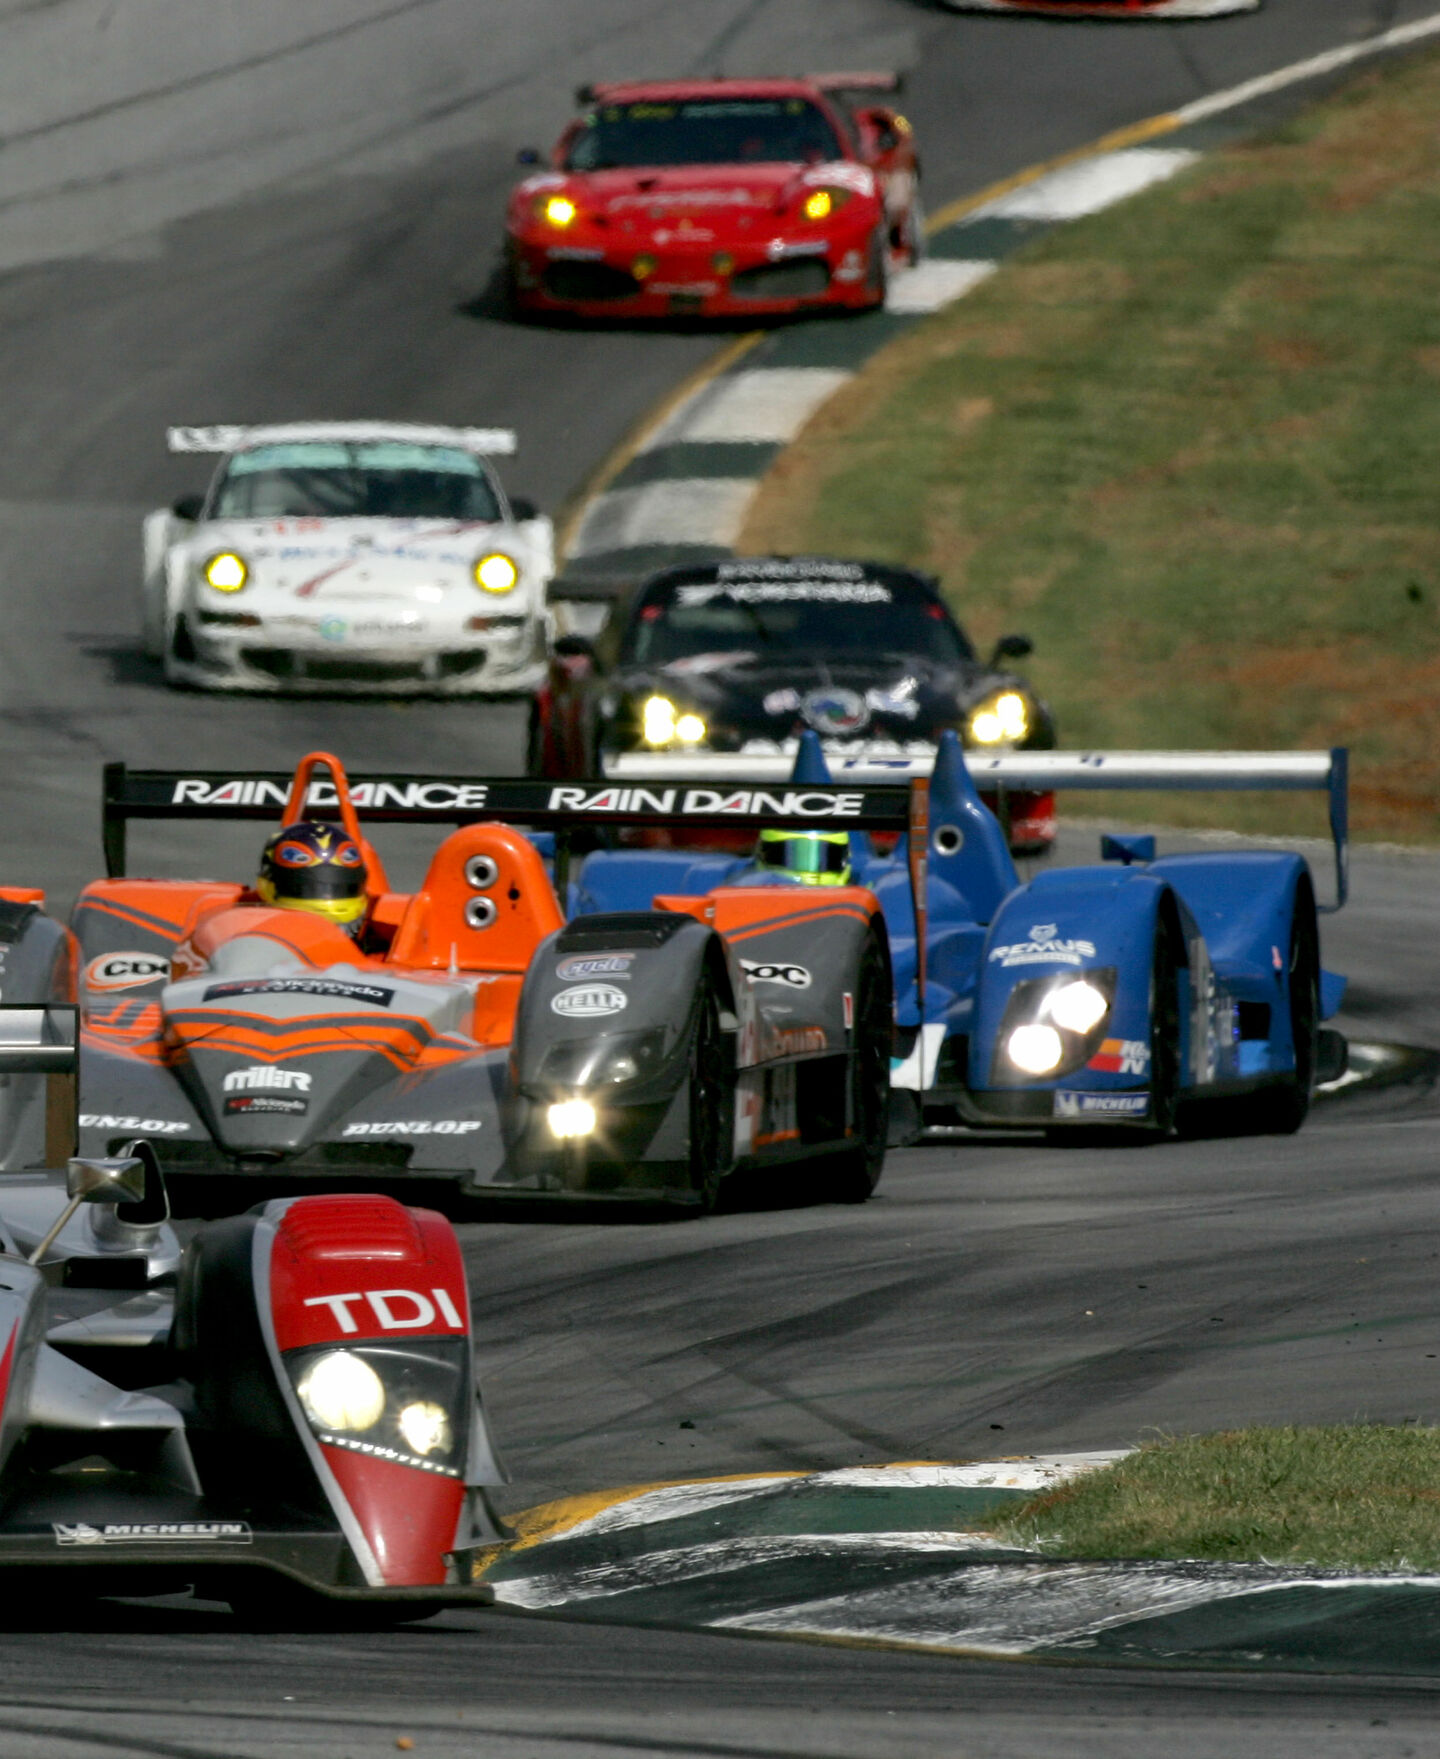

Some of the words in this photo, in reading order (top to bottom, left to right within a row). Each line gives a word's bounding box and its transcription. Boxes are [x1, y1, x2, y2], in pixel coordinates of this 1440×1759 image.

[171, 779, 294, 806] RAIN
[303, 781, 489, 809] DANCE
[547, 786, 673, 813] RAIN
[682, 790, 865, 817] DANCE
[988, 939, 1097, 963] REMUS
[557, 992, 627, 1009] HELLA
[78, 1113, 191, 1133] UNLOP
[342, 1120, 482, 1137] DUNLOP
[303, 1288, 464, 1333] TDI
[104, 1524, 243, 1535] MICHELIN
